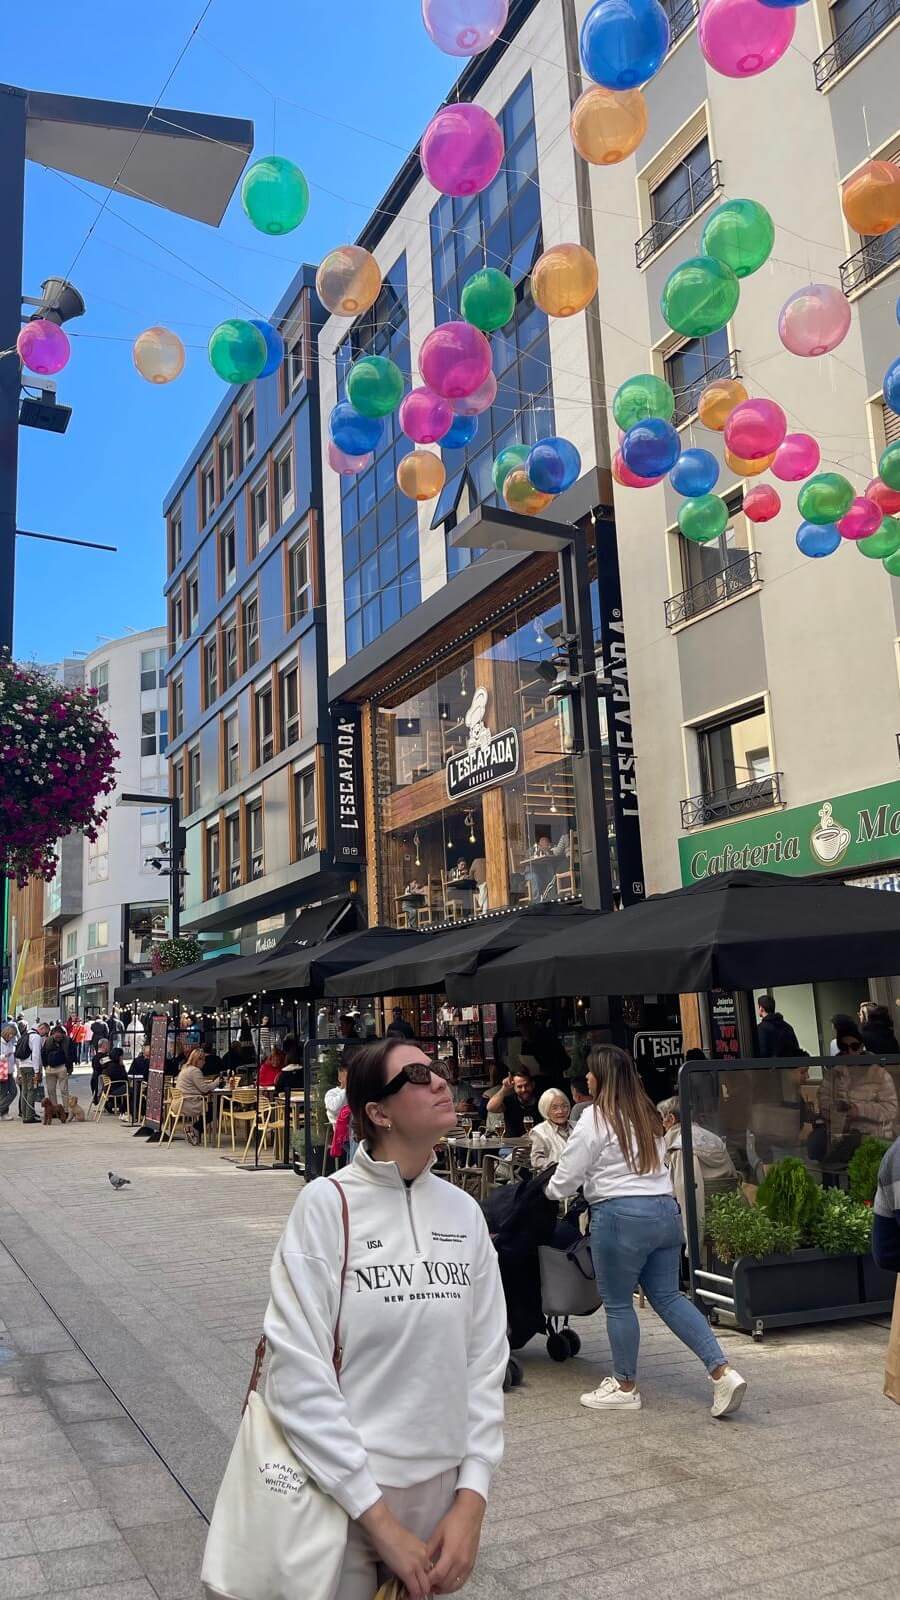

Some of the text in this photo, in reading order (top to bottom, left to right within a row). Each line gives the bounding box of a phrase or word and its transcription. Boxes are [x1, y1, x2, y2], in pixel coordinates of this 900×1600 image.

[338, 718, 359, 829] L'ESCAPADA
[449, 737, 514, 788] L'ESCAPADA
[691, 831, 800, 880] Cafeteria
[640, 1036, 681, 1058] L'ESC
[367, 1240, 383, 1250] USA
[354, 1261, 471, 1292] NEW YORK
[384, 1295, 404, 1303] NEW
[258, 1463, 271, 1473] LE
[278, 1473, 288, 1482] DE
